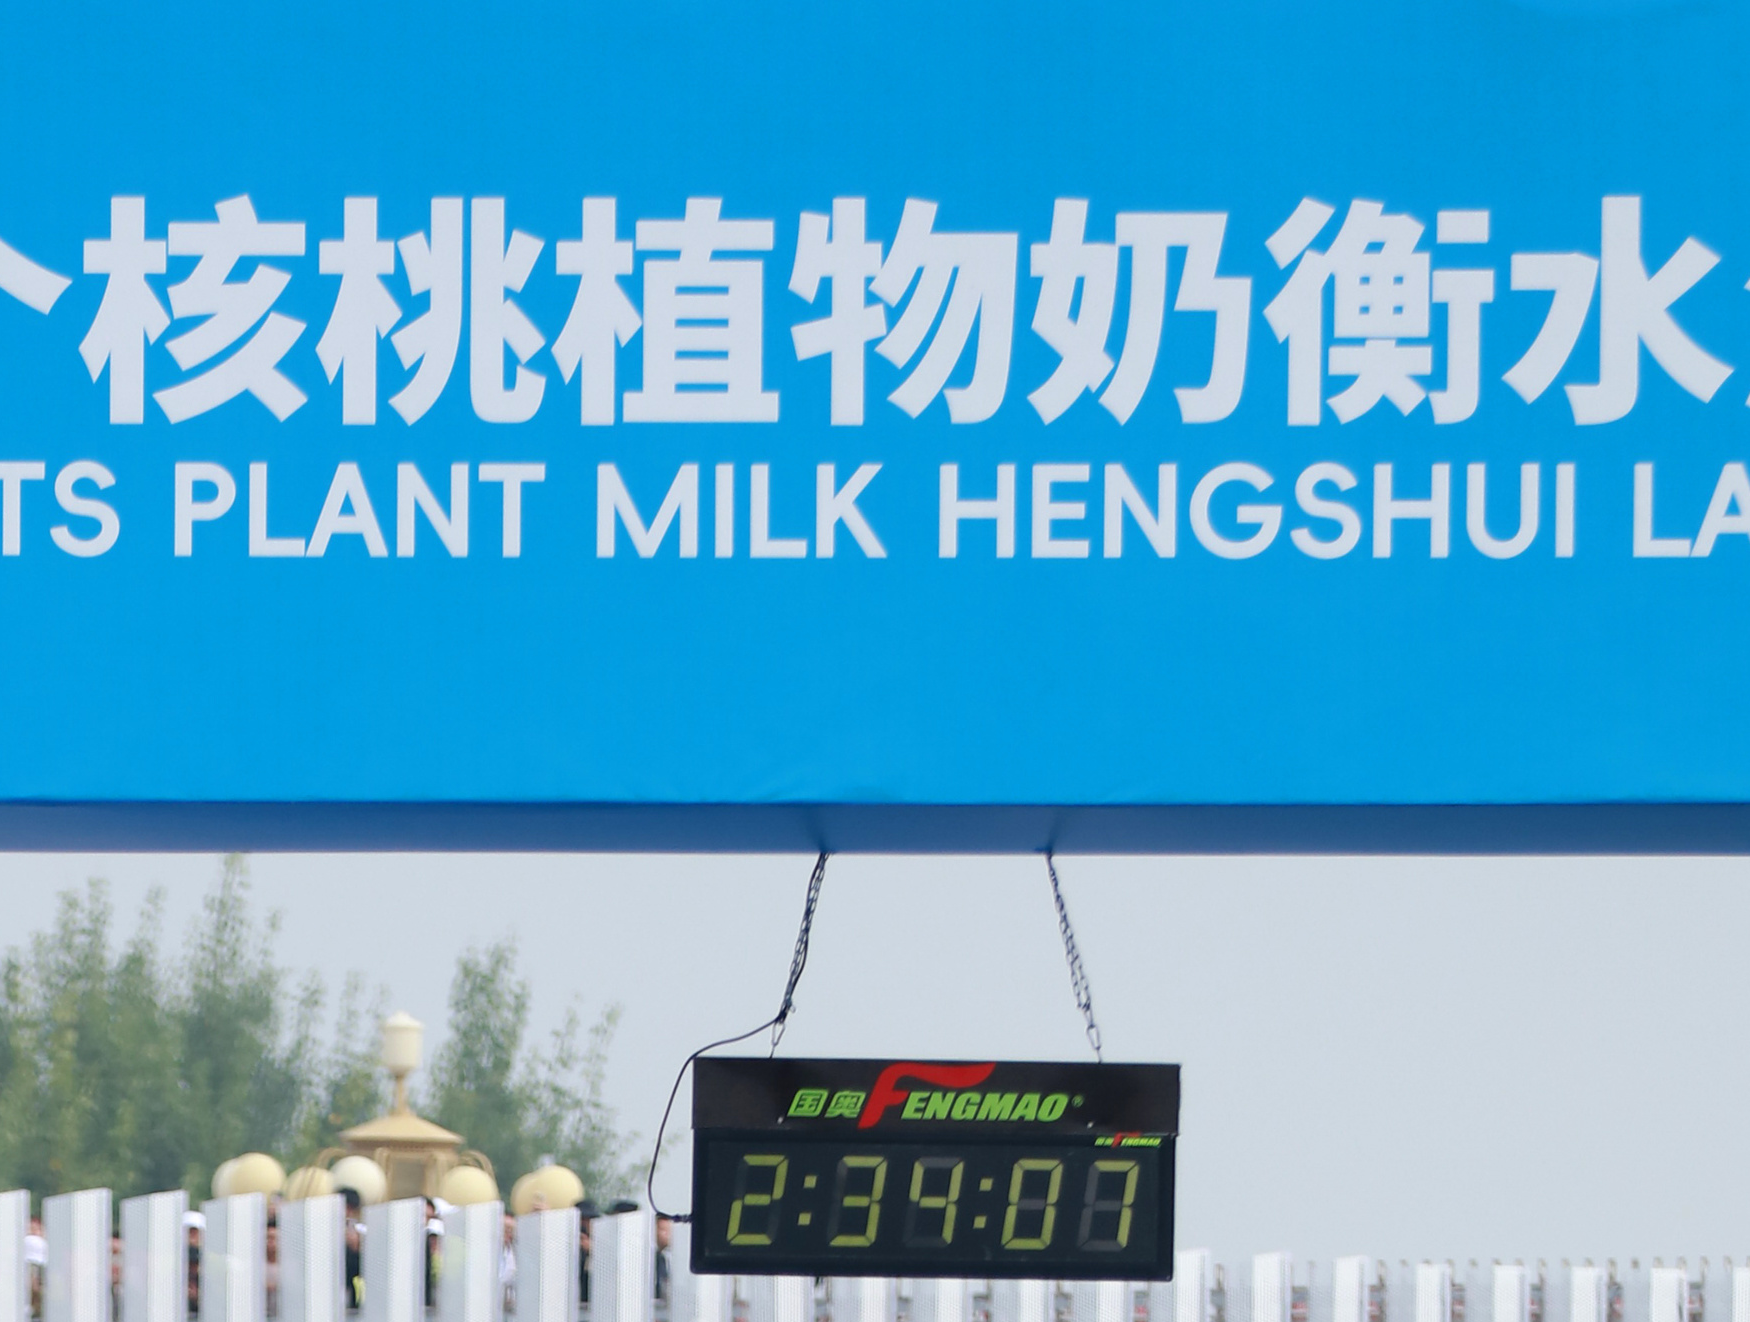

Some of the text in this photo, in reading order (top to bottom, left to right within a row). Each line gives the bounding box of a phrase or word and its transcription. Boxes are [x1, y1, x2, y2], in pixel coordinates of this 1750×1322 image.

[173, 462, 545, 559] PLANT
[596, 462, 887, 560] MILK
[938, 462, 1577, 561] HENGSHUI
[727, 1155, 1139, 1250] 2:34:07
